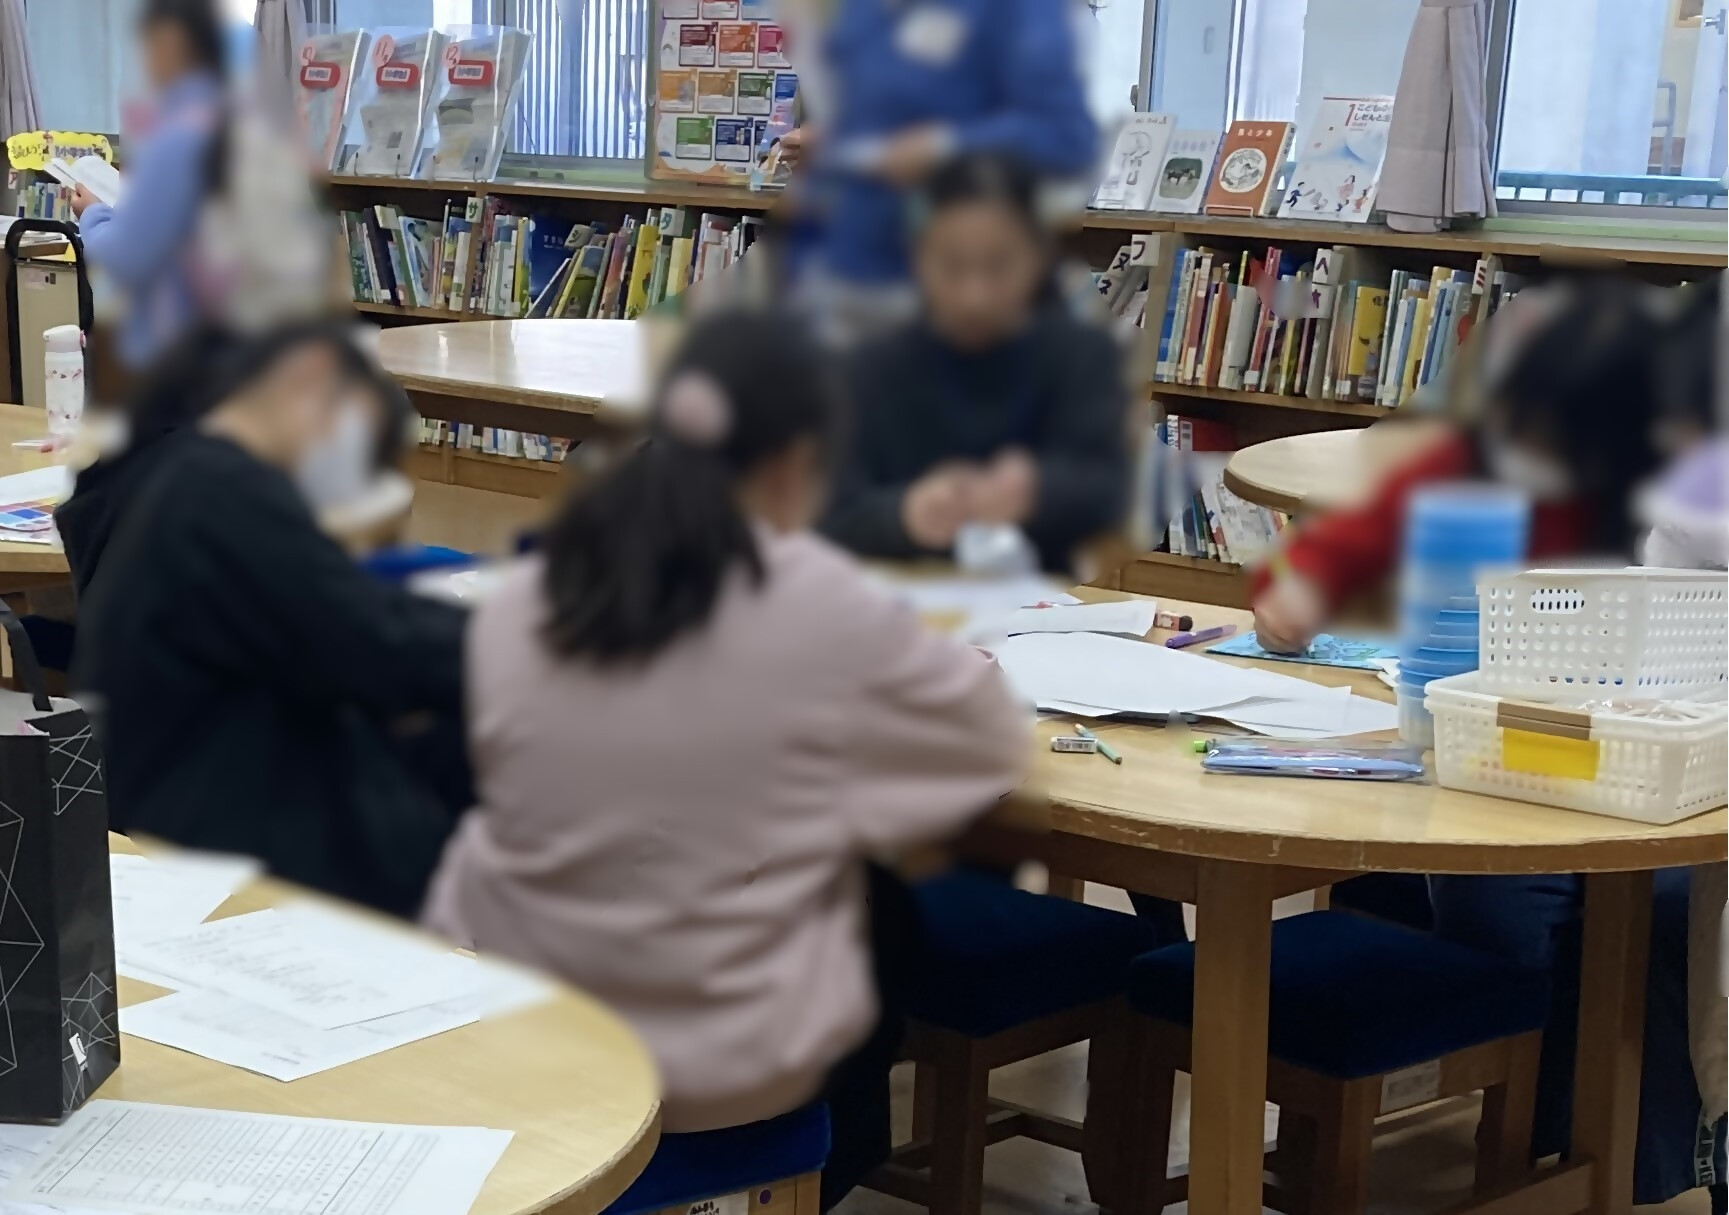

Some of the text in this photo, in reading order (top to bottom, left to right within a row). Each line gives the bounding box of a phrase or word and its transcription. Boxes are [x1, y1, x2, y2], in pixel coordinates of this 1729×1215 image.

[468, 201, 479, 219] サ
[1132, 240, 1146, 261] フ
[1476, 266, 1487, 288] ミ
